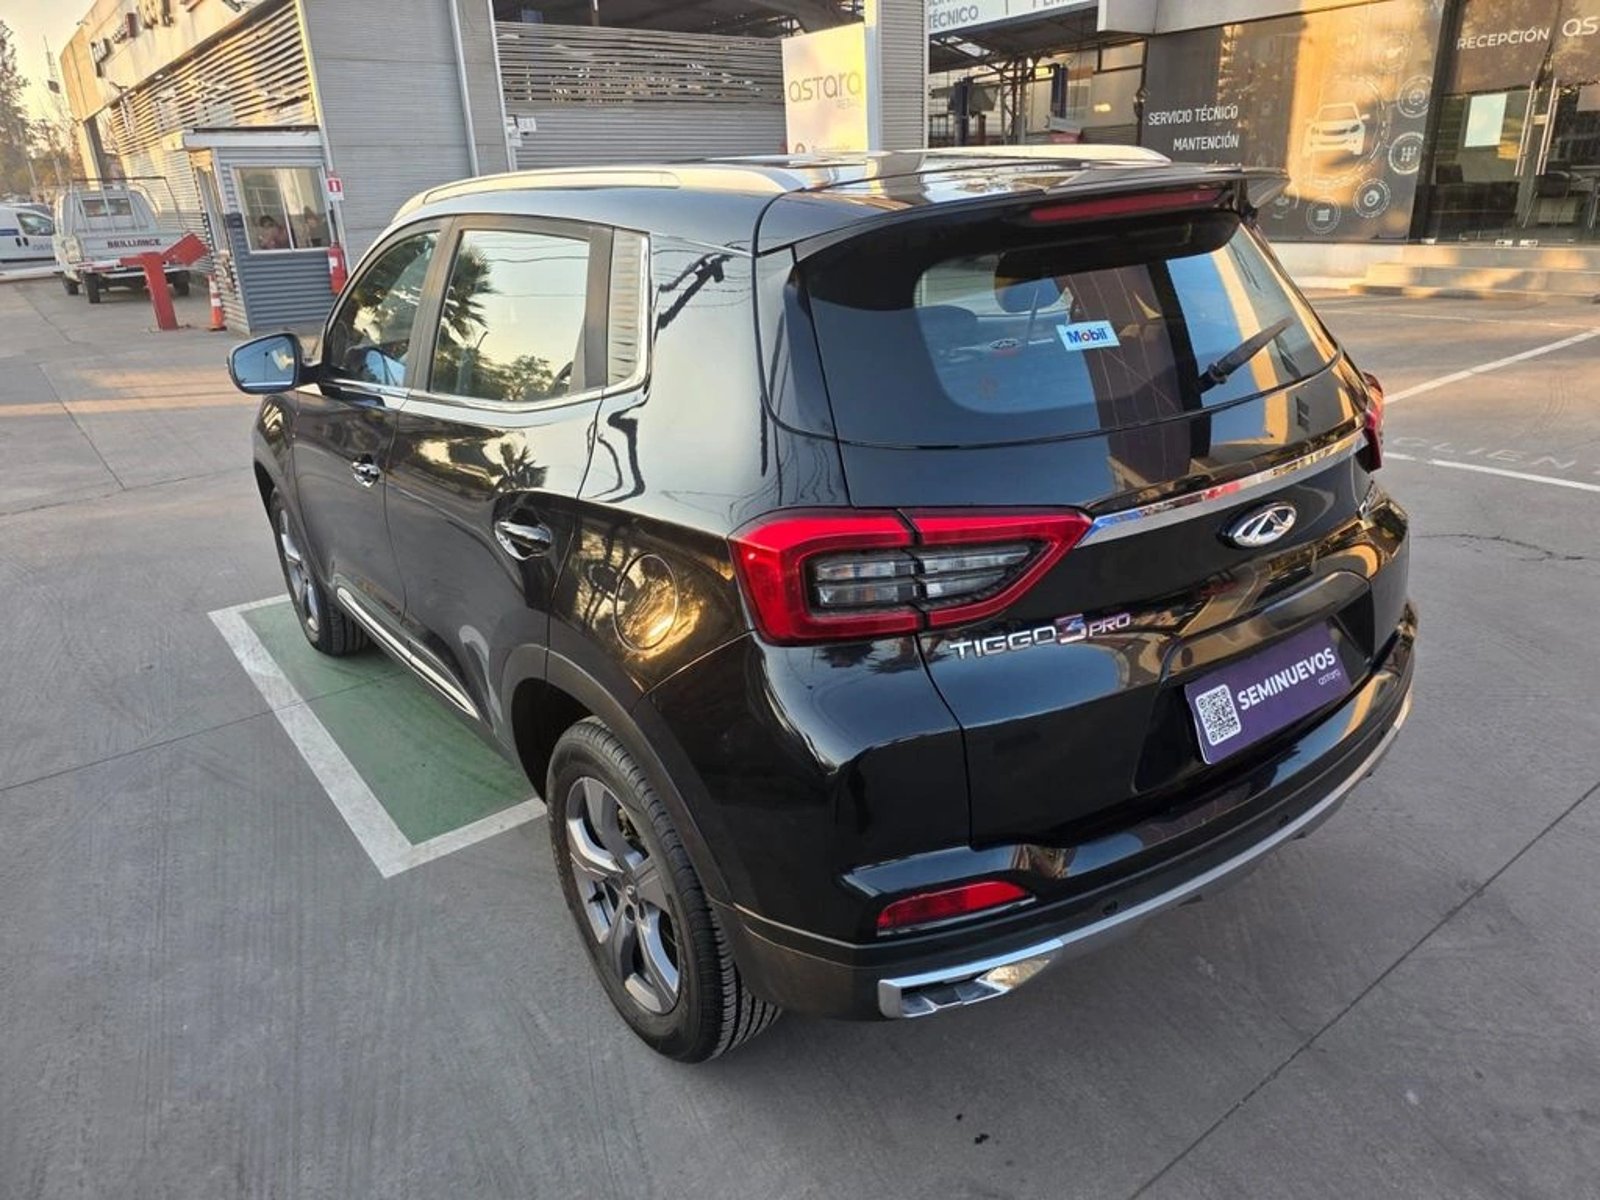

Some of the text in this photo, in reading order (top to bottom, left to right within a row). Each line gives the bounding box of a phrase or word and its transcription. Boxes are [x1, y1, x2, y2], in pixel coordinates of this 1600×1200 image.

[1456, 26, 1550, 50] RECEPCIÓN
[1148, 102, 1239, 126] SERVICIO TÉCNICO
[1173, 130, 1240, 151] MANTENCIÓN
[107, 238, 161, 249] BRILLIANCE
[1066, 328, 1109, 343] Mobil
[949, 625, 1057, 660] TIGGO
[1088, 613, 1131, 638] PRO
[1237, 648, 1336, 710] SEMINUEVOS
